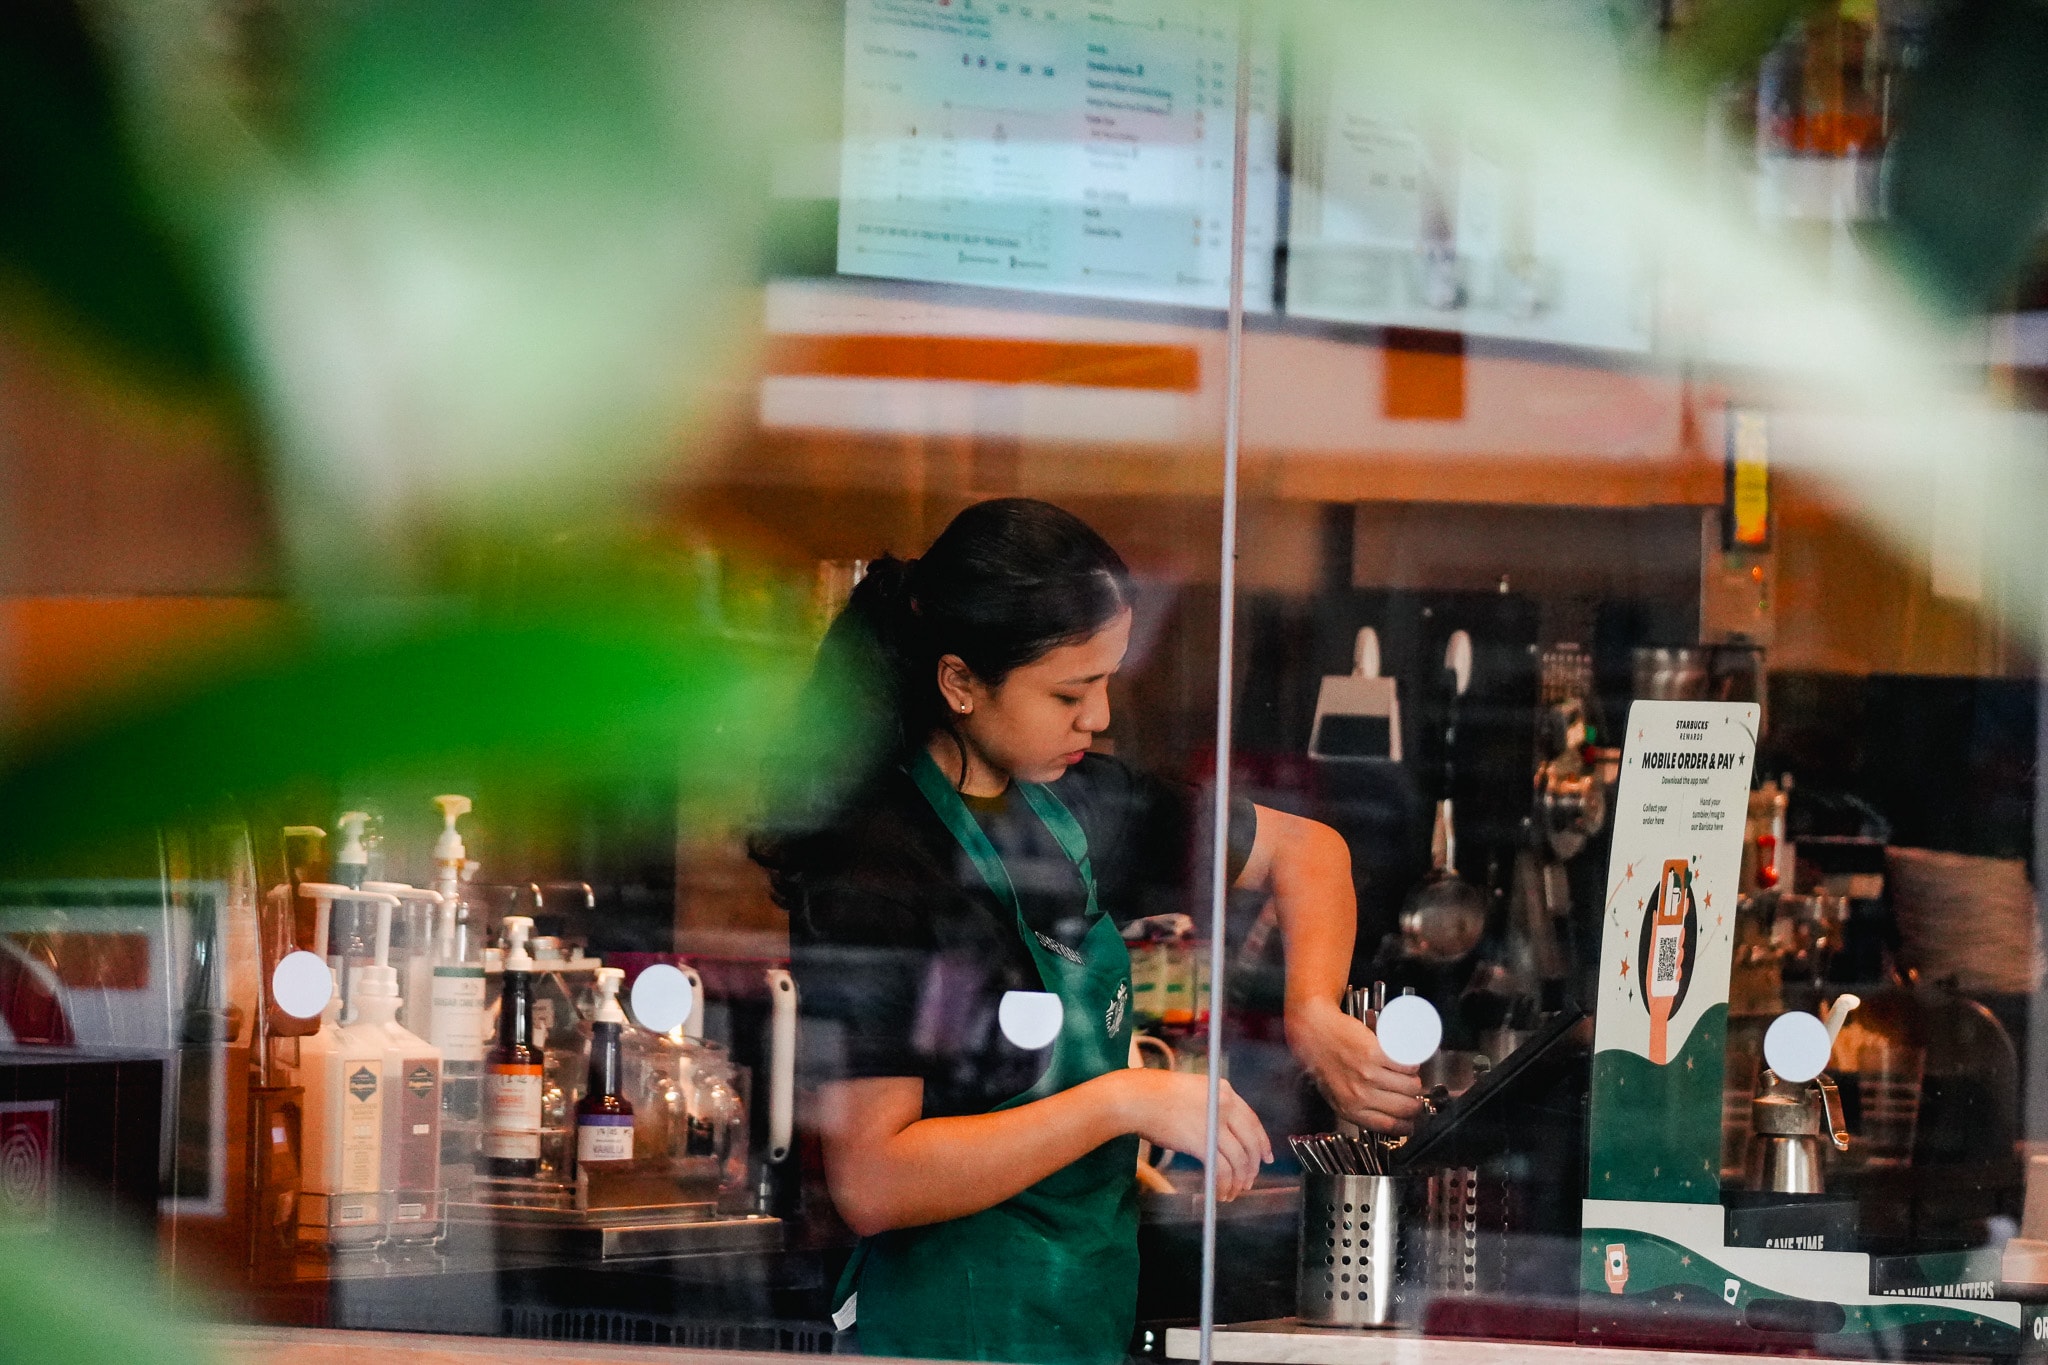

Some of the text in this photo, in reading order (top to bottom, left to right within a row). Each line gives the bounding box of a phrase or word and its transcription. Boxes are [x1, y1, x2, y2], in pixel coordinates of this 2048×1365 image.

[1676, 720, 1709, 730] STARBUCKS
[1679, 733, 1703, 741] REWARDS
[1642, 752, 1735, 770] MOBILE ORDER & PAY
[1661, 776, 1709, 786] Download the app now!
[1699, 797, 1721, 807] Hand your
[1642, 803, 1667, 813] Collect your
[1692, 810, 1725, 820] tumbler/mug to
[1642, 816, 1665, 825] order here
[1698, 822, 1714, 831] Barista
[1714, 823, 1723, 831] here
[1795, 1235, 1824, 1250] TIME
[1944, 1280, 1994, 1299] MATTERS
[2033, 1316, 2048, 1340] OR
